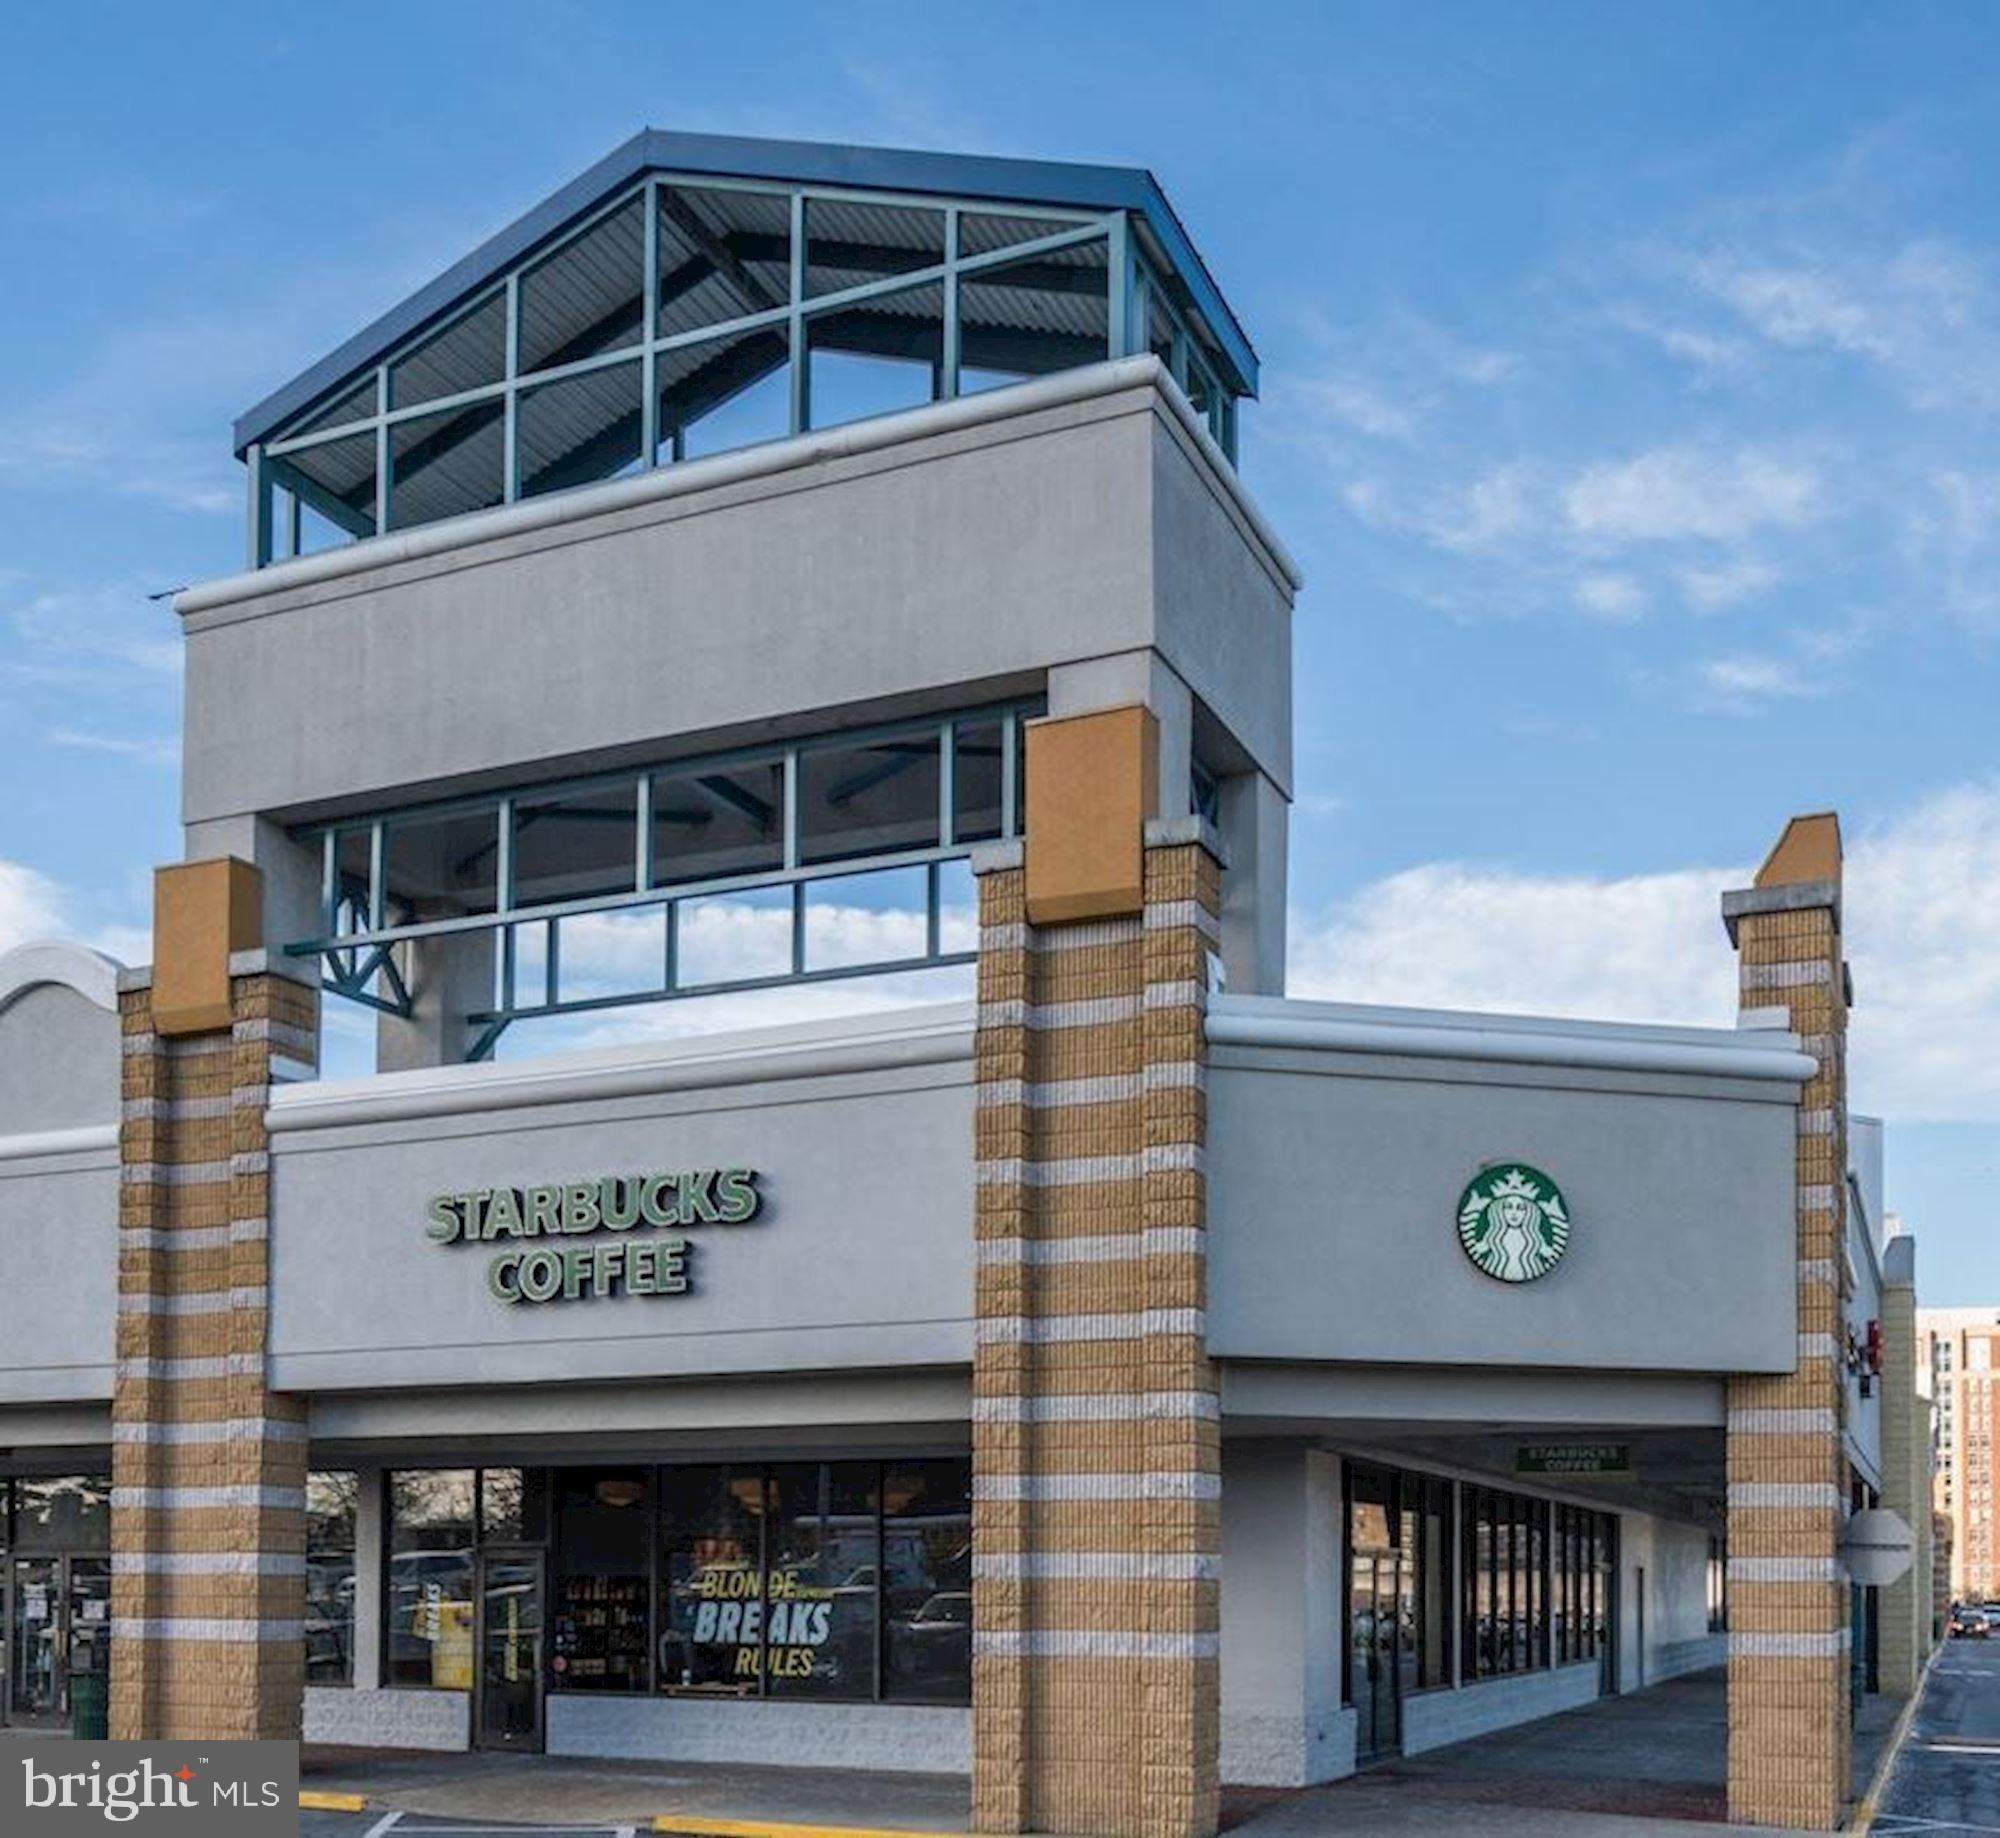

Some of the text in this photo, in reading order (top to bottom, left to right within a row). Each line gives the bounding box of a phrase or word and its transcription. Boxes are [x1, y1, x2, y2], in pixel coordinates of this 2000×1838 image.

[425, 1168, 758, 1243] STARBUCKS
[488, 1241, 688, 1302] COFFEE
[693, 1601, 832, 1645] BREAKS
